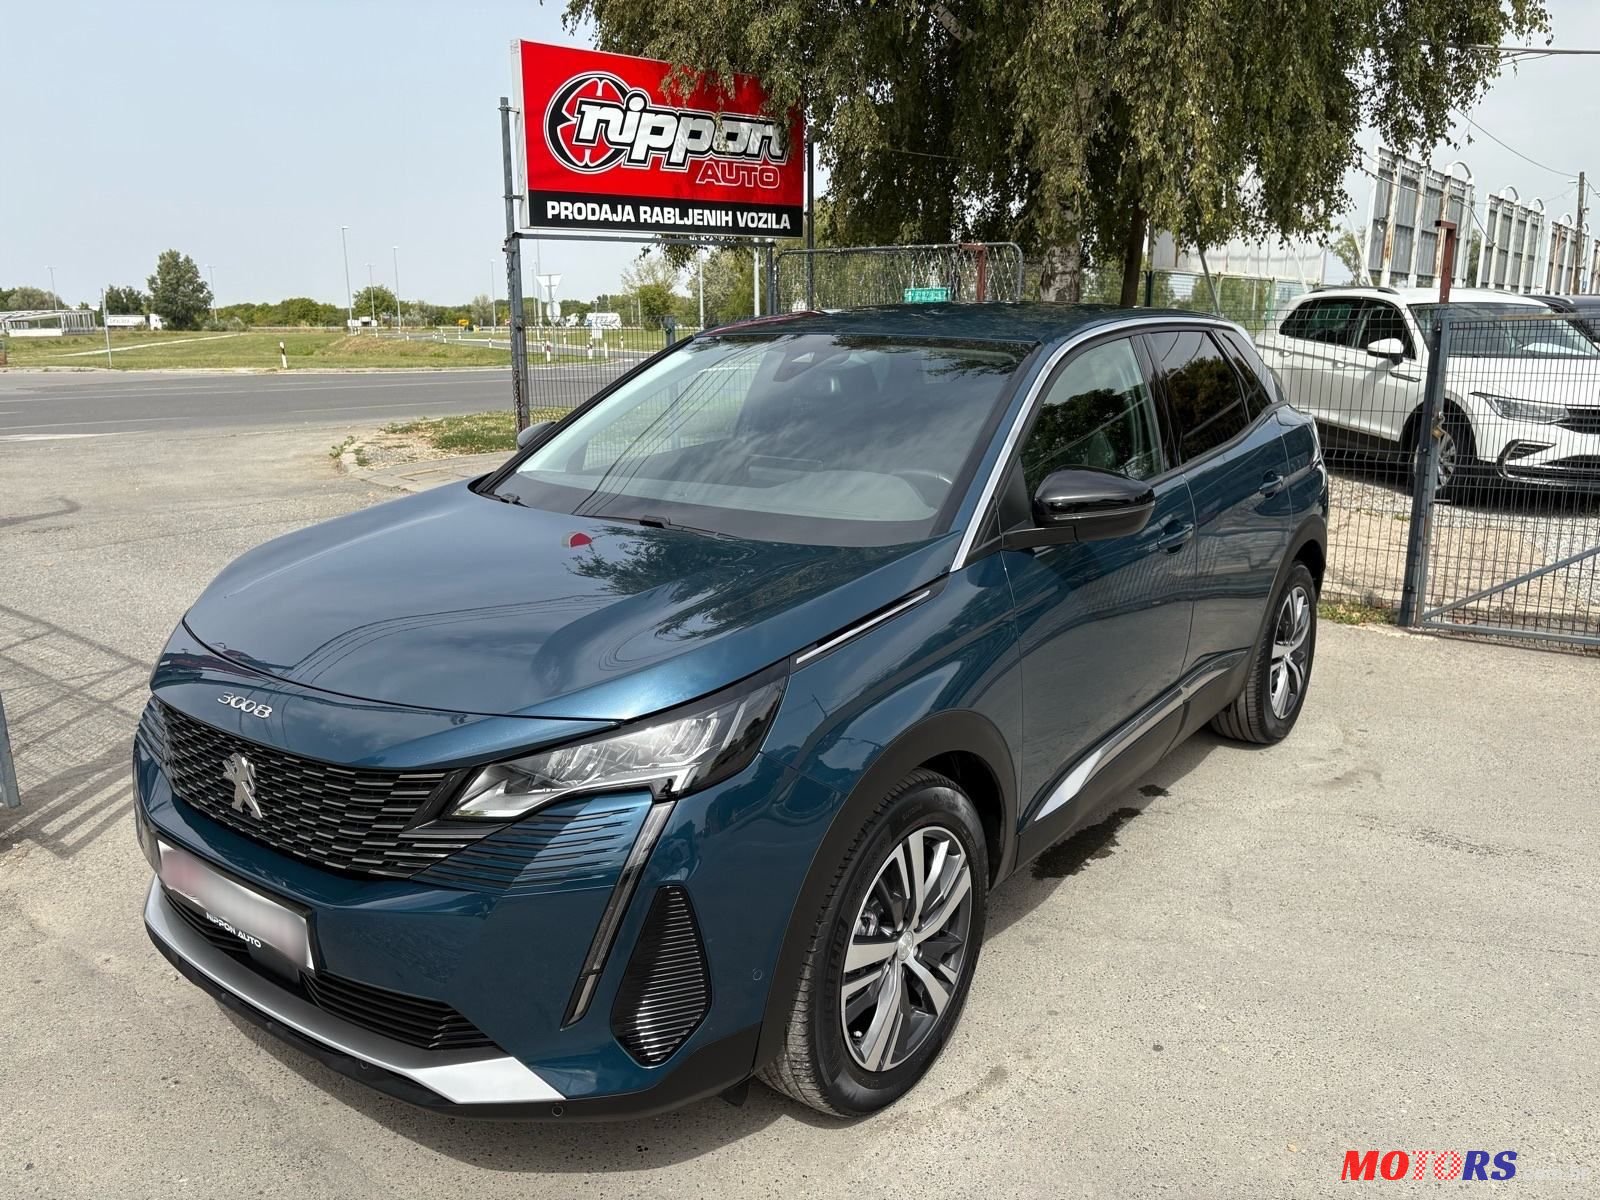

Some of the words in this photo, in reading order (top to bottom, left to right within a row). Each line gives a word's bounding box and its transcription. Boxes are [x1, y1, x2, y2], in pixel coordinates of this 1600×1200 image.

[574, 90, 785, 169] nippon
[696, 161, 780, 188] AUTO
[546, 201, 635, 222] PRODAJA
[640, 205, 733, 227] RABLJENIH
[736, 211, 791, 229] VOZILA
[217, 691, 273, 718] 3008
[206, 911, 236, 935] NIPPON
[237, 930, 262, 948] AUTO
